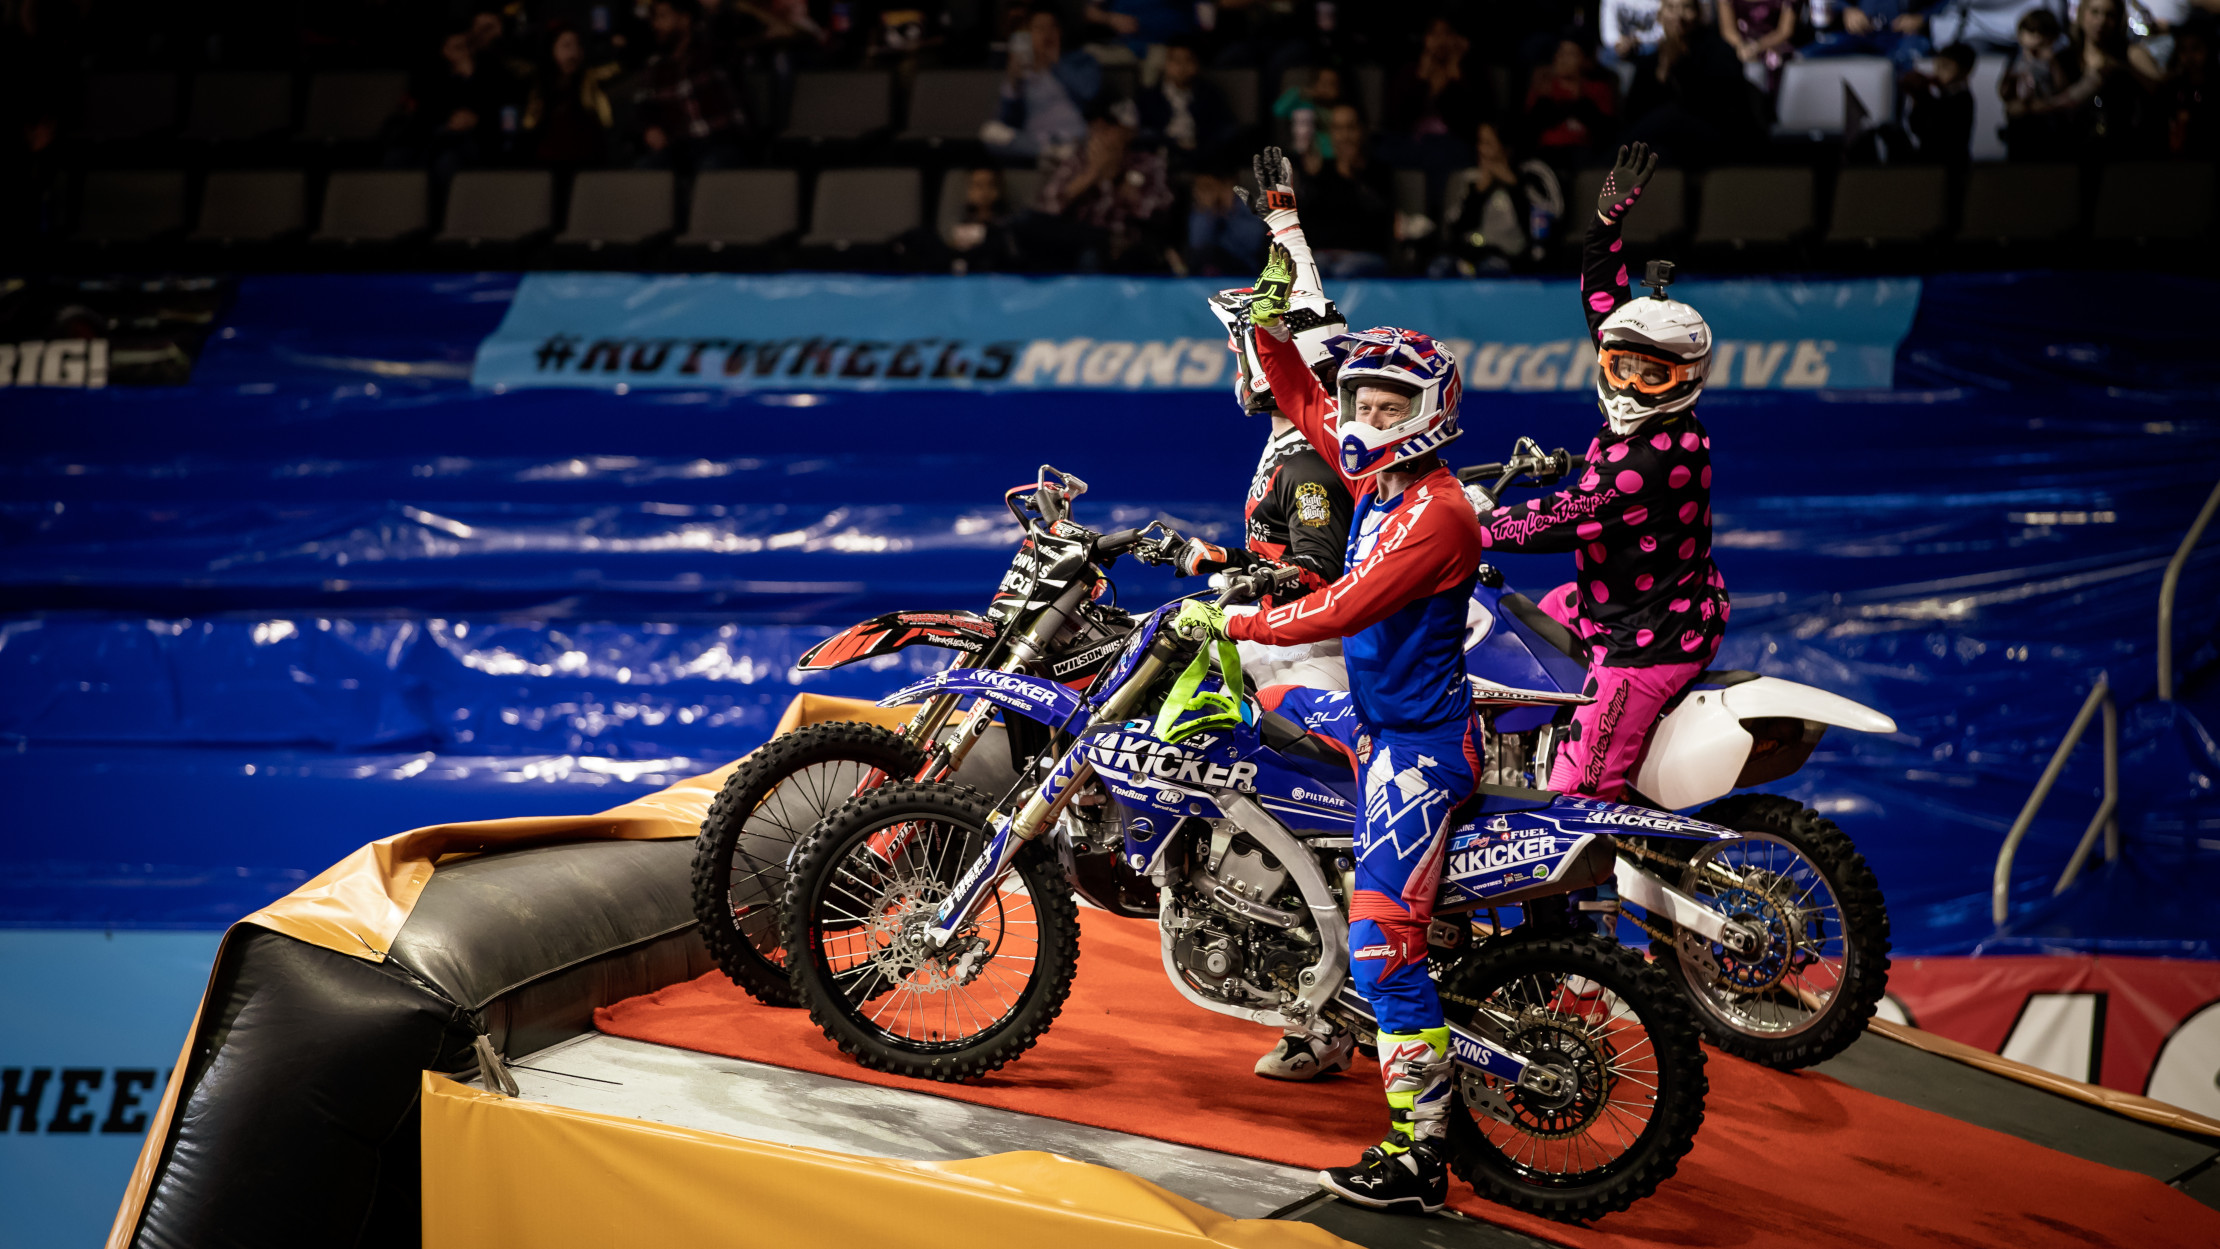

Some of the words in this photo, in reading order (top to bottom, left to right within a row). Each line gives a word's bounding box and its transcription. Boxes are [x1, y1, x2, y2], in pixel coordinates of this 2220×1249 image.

[1253, 378, 1268, 389] BEL
[1053, 646, 1104, 676] WILSON
[983, 671, 1059, 706] KICKER
[1115, 736, 1258, 790] KICKER
[1304, 792, 1345, 807] FILTRATE
[1510, 828, 1548, 840] FUEL
[1602, 813, 1683, 832] KICKER
[1468, 836, 1556, 872] KICKER
[1452, 1035, 1493, 1066] KINS
[0, 1067, 157, 1134] HEE
